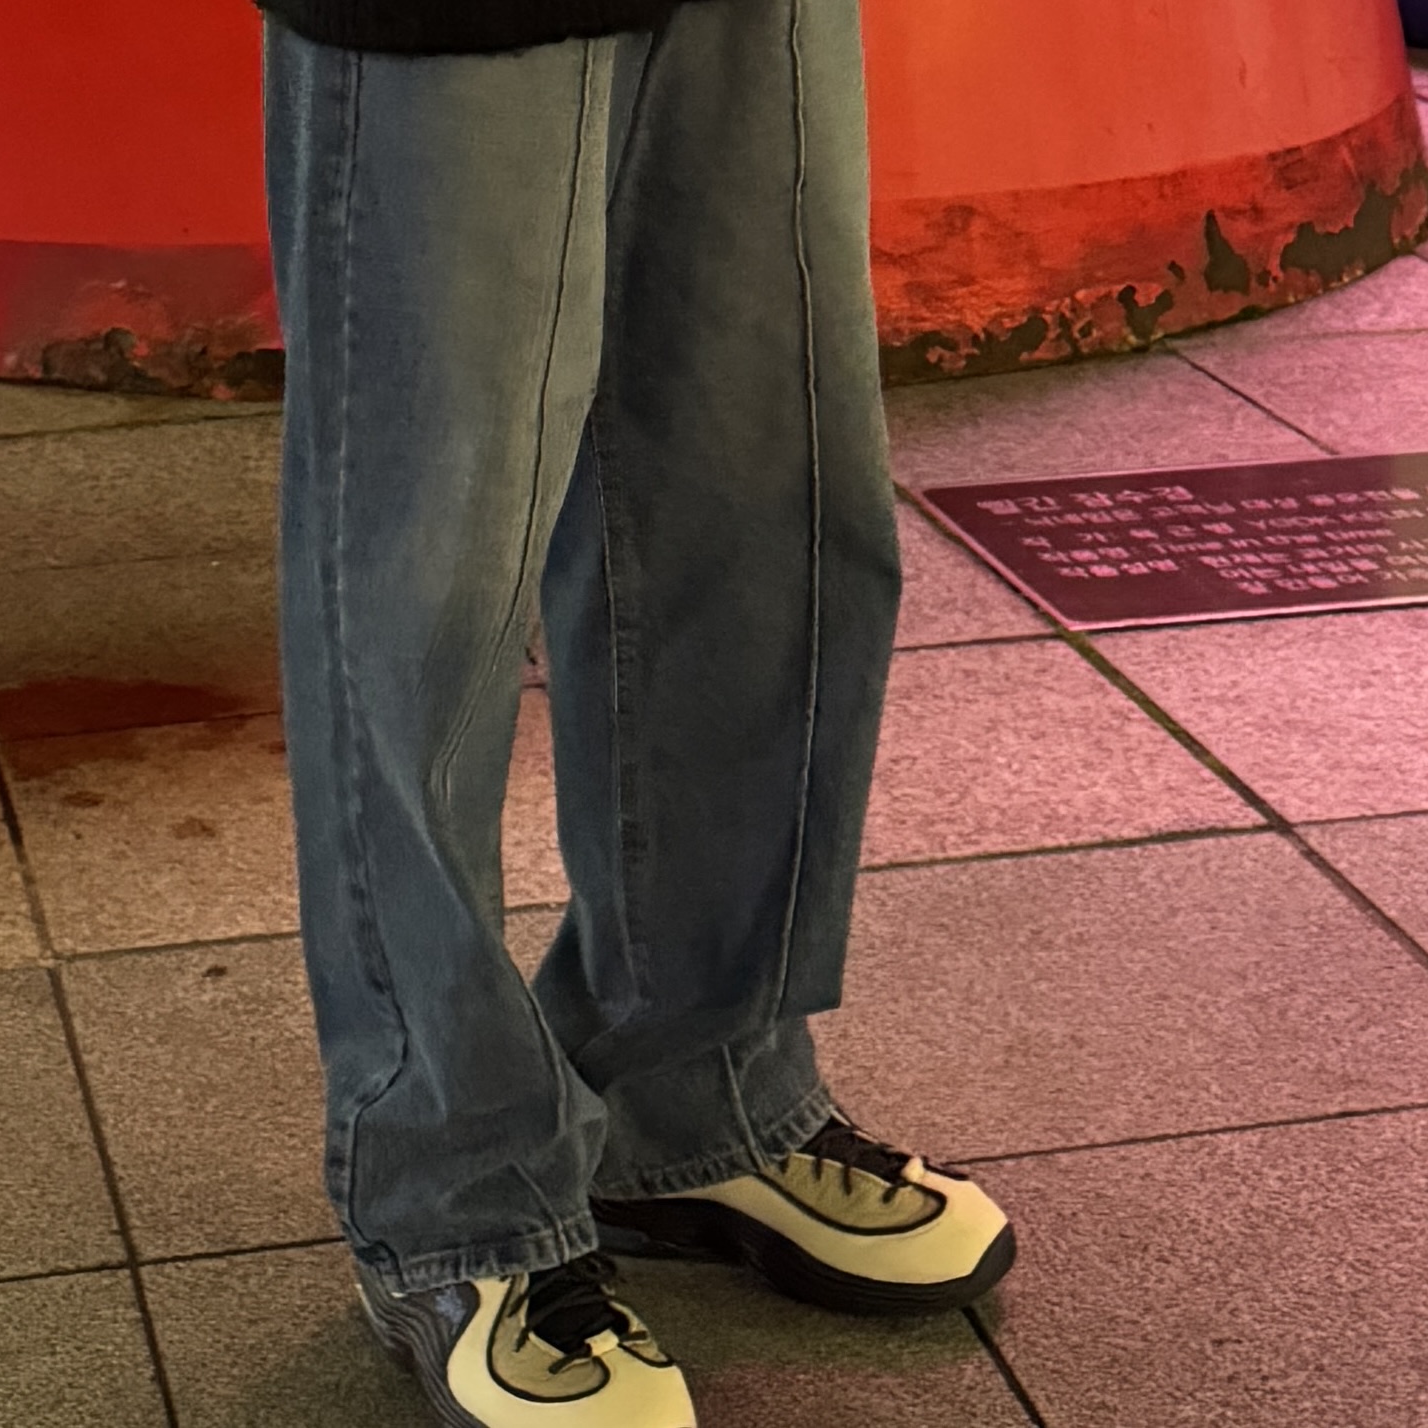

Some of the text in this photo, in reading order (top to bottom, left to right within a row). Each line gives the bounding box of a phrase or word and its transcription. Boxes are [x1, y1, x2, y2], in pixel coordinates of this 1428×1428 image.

[1148, 541, 1224, 554] Time
[1229, 538, 1262, 548] in
[1264, 534, 1319, 544] the
[1324, 529, 1397, 540] time
